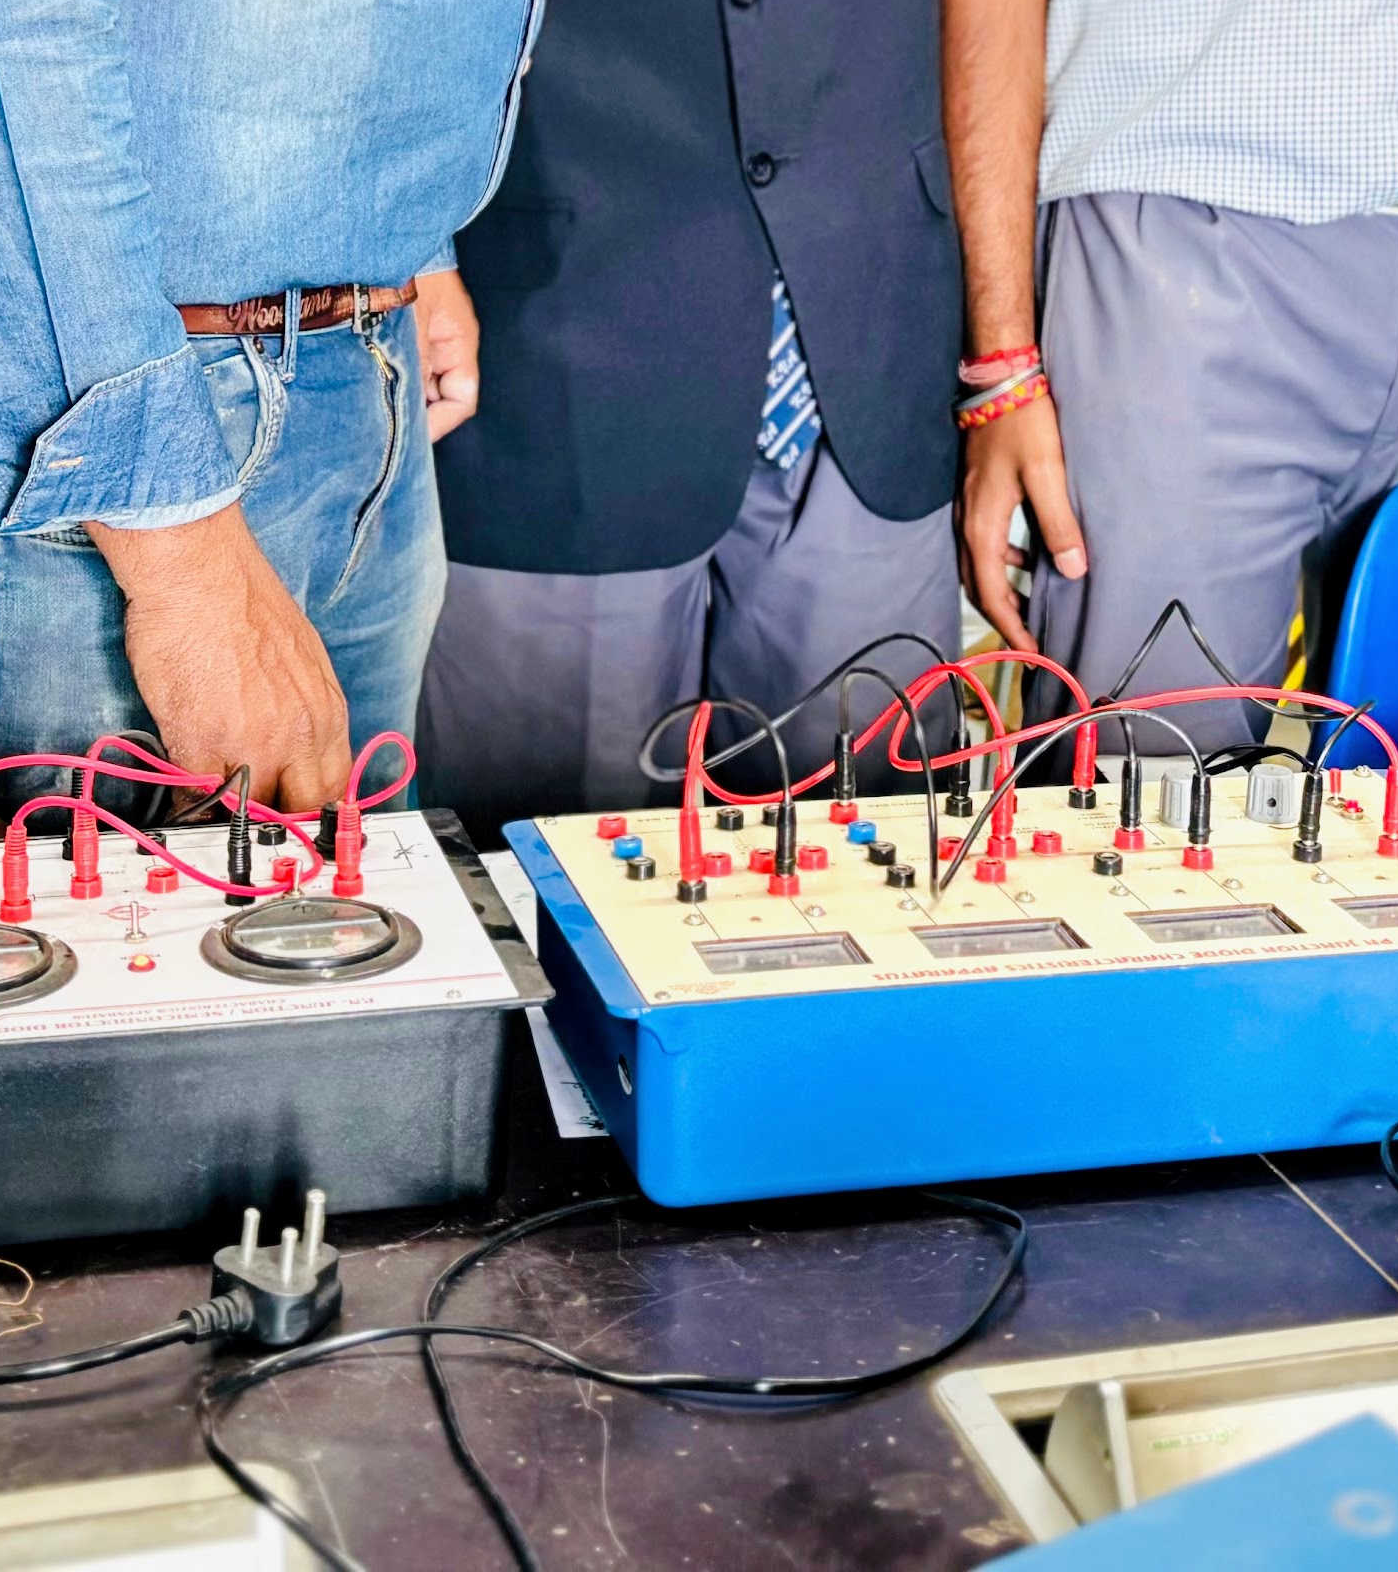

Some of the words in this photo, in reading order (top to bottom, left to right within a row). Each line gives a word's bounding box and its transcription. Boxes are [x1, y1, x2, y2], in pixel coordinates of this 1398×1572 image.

[1192, 947, 1257, 960] DIODE
[1263, 939, 1361, 954] JUNCTION
[1004, 952, 1186, 973] CHARACTERISTICS
[872, 965, 999, 981] APPARATUS
[241, 1000, 336, 1015] JUNCTION
[55, 1009, 223, 1029] SEMICONDUCTOR
